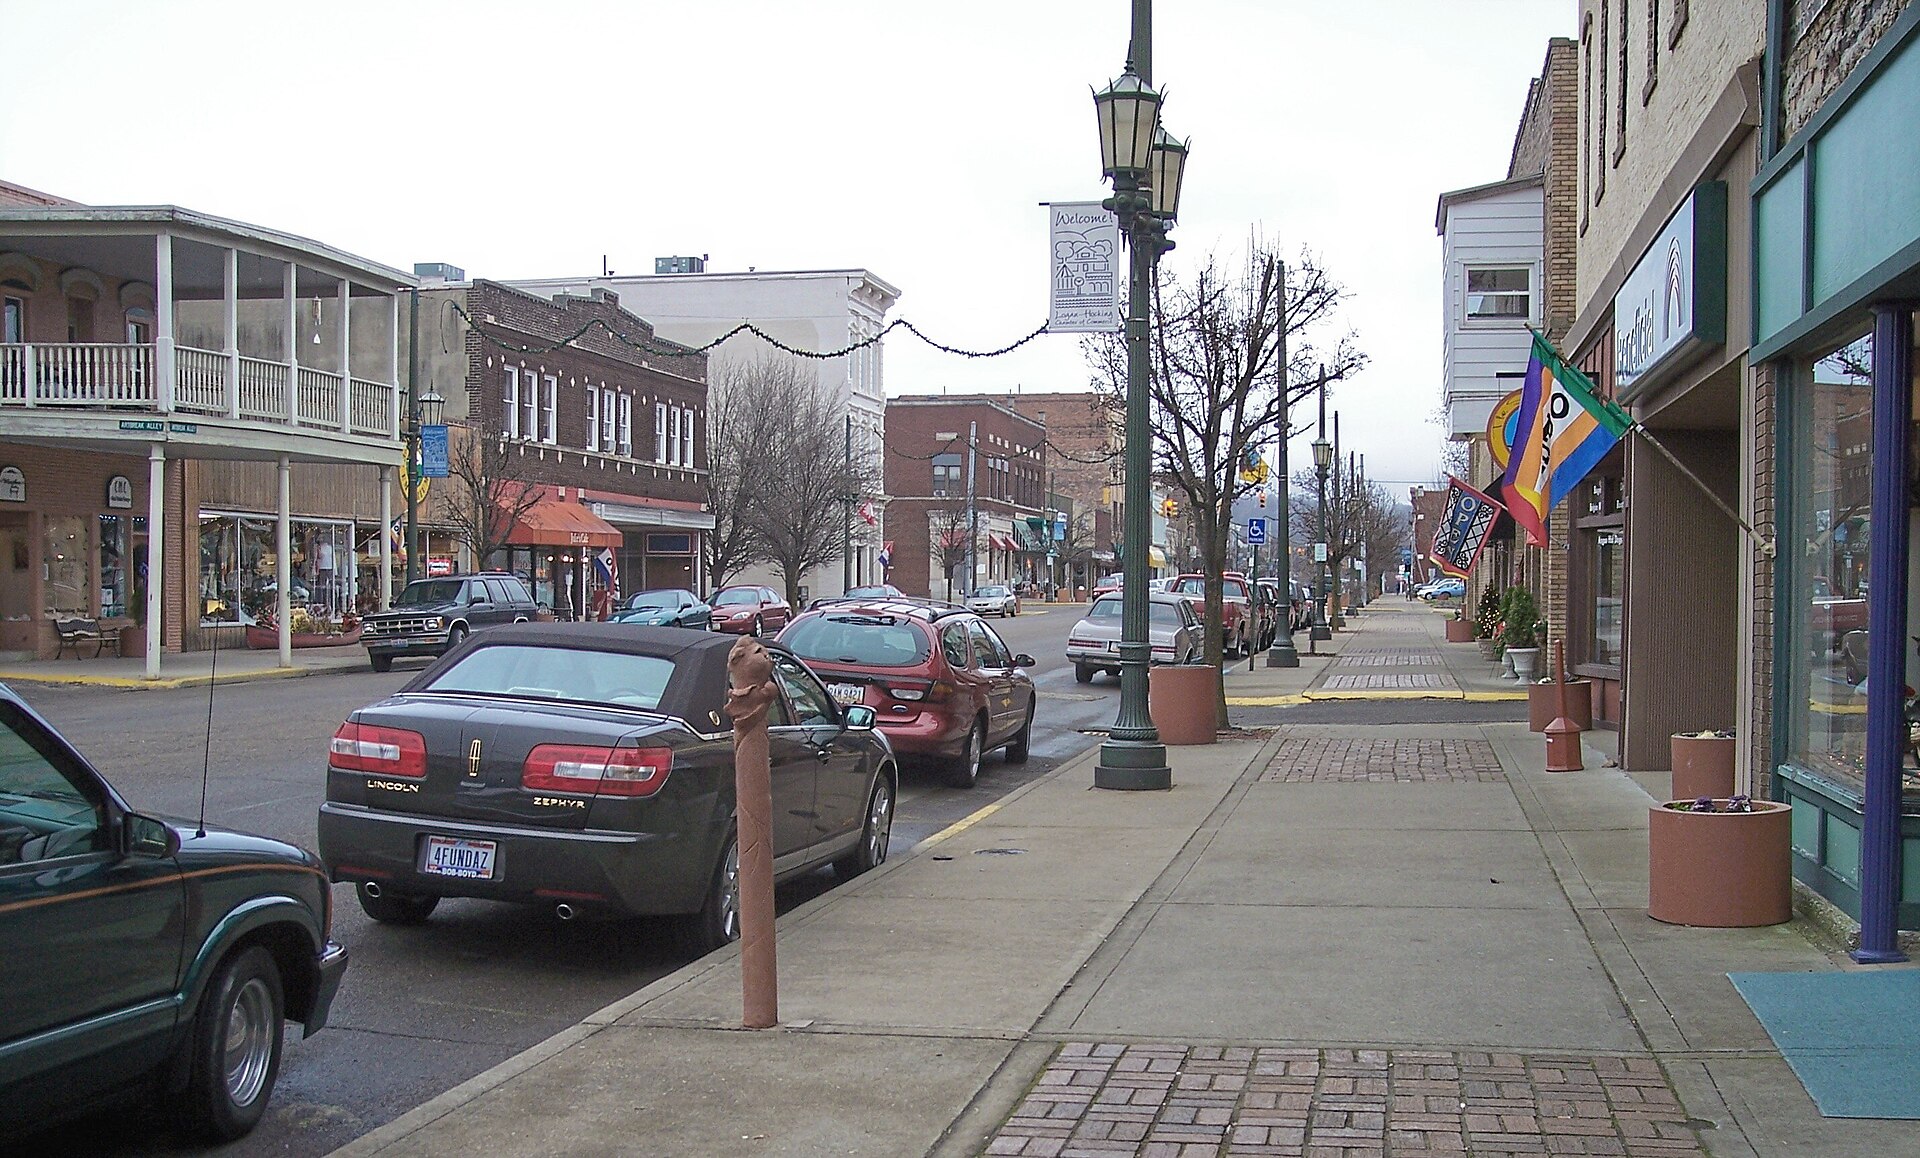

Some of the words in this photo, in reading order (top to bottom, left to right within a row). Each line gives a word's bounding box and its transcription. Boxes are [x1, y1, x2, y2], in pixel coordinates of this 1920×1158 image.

[1055, 211, 1113, 226] Welcome!
[1616, 289, 1655, 386] Beneficial
[146, 422, 163, 431] ALLEY
[367, 780, 420, 793] LINCOLN
[533, 797, 585, 809] ZEPHYR
[434, 846, 489, 869] 4FUNDAZ
